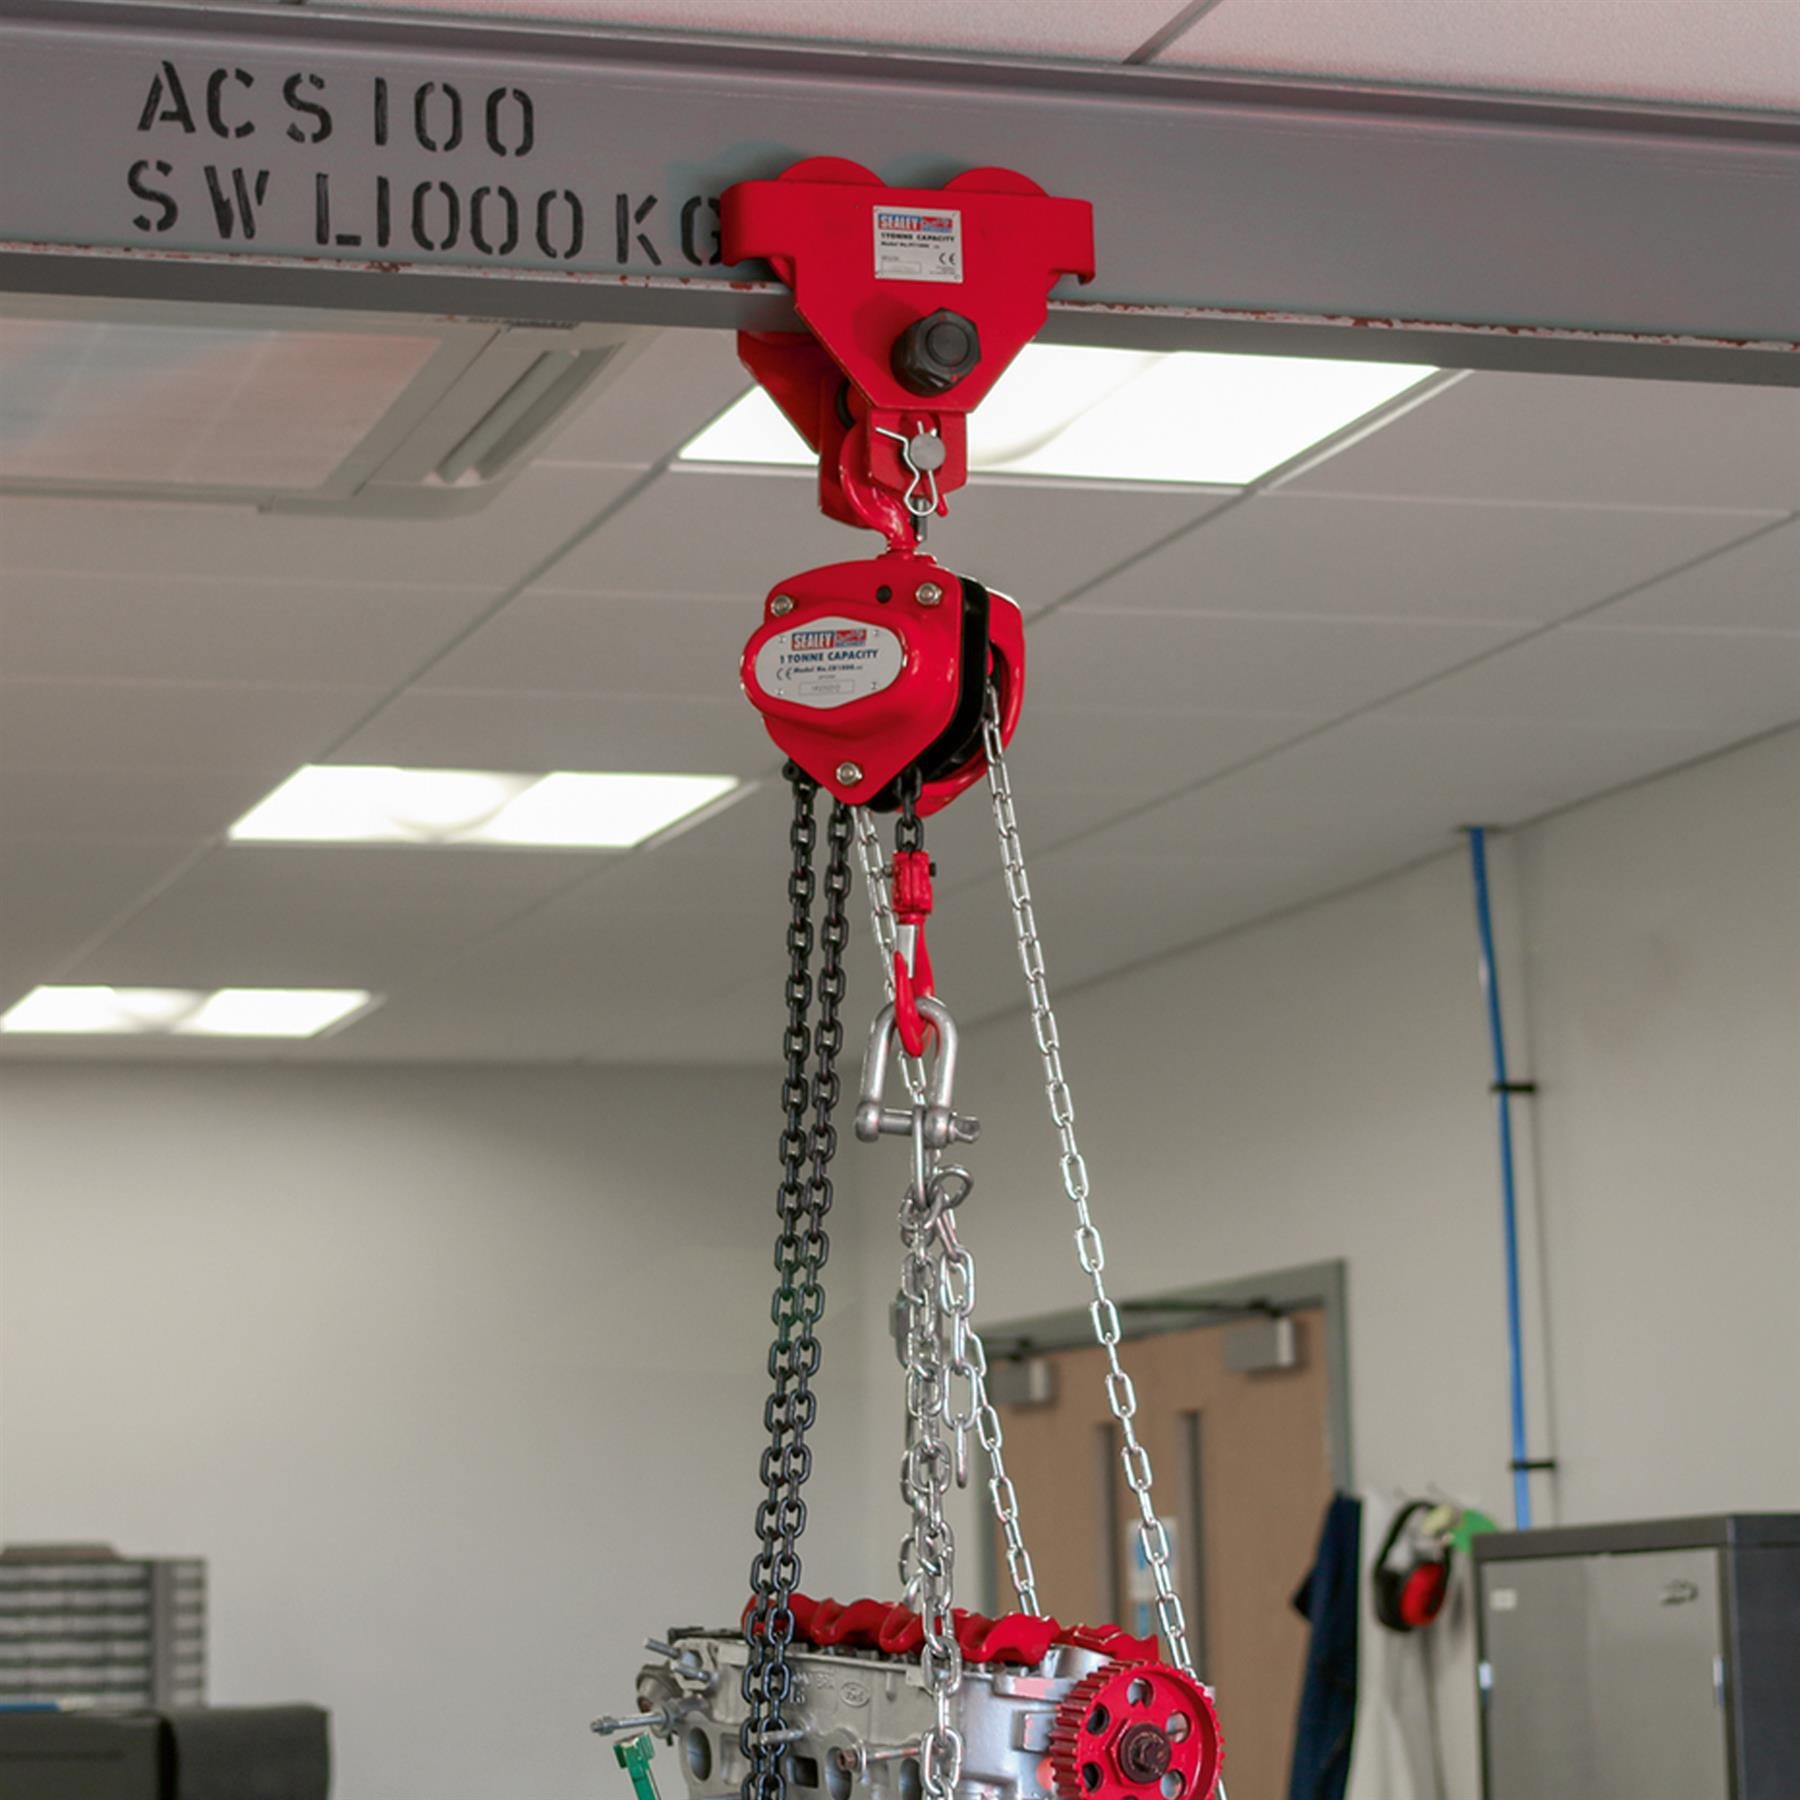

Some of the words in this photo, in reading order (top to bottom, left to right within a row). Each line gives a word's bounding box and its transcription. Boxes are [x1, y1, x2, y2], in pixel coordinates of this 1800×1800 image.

[373, 76, 534, 157] 100
[793, 632, 833, 650] SEALEY
[787, 653, 824, 663] TONNE
[827, 649, 879, 661] CAPACITY
